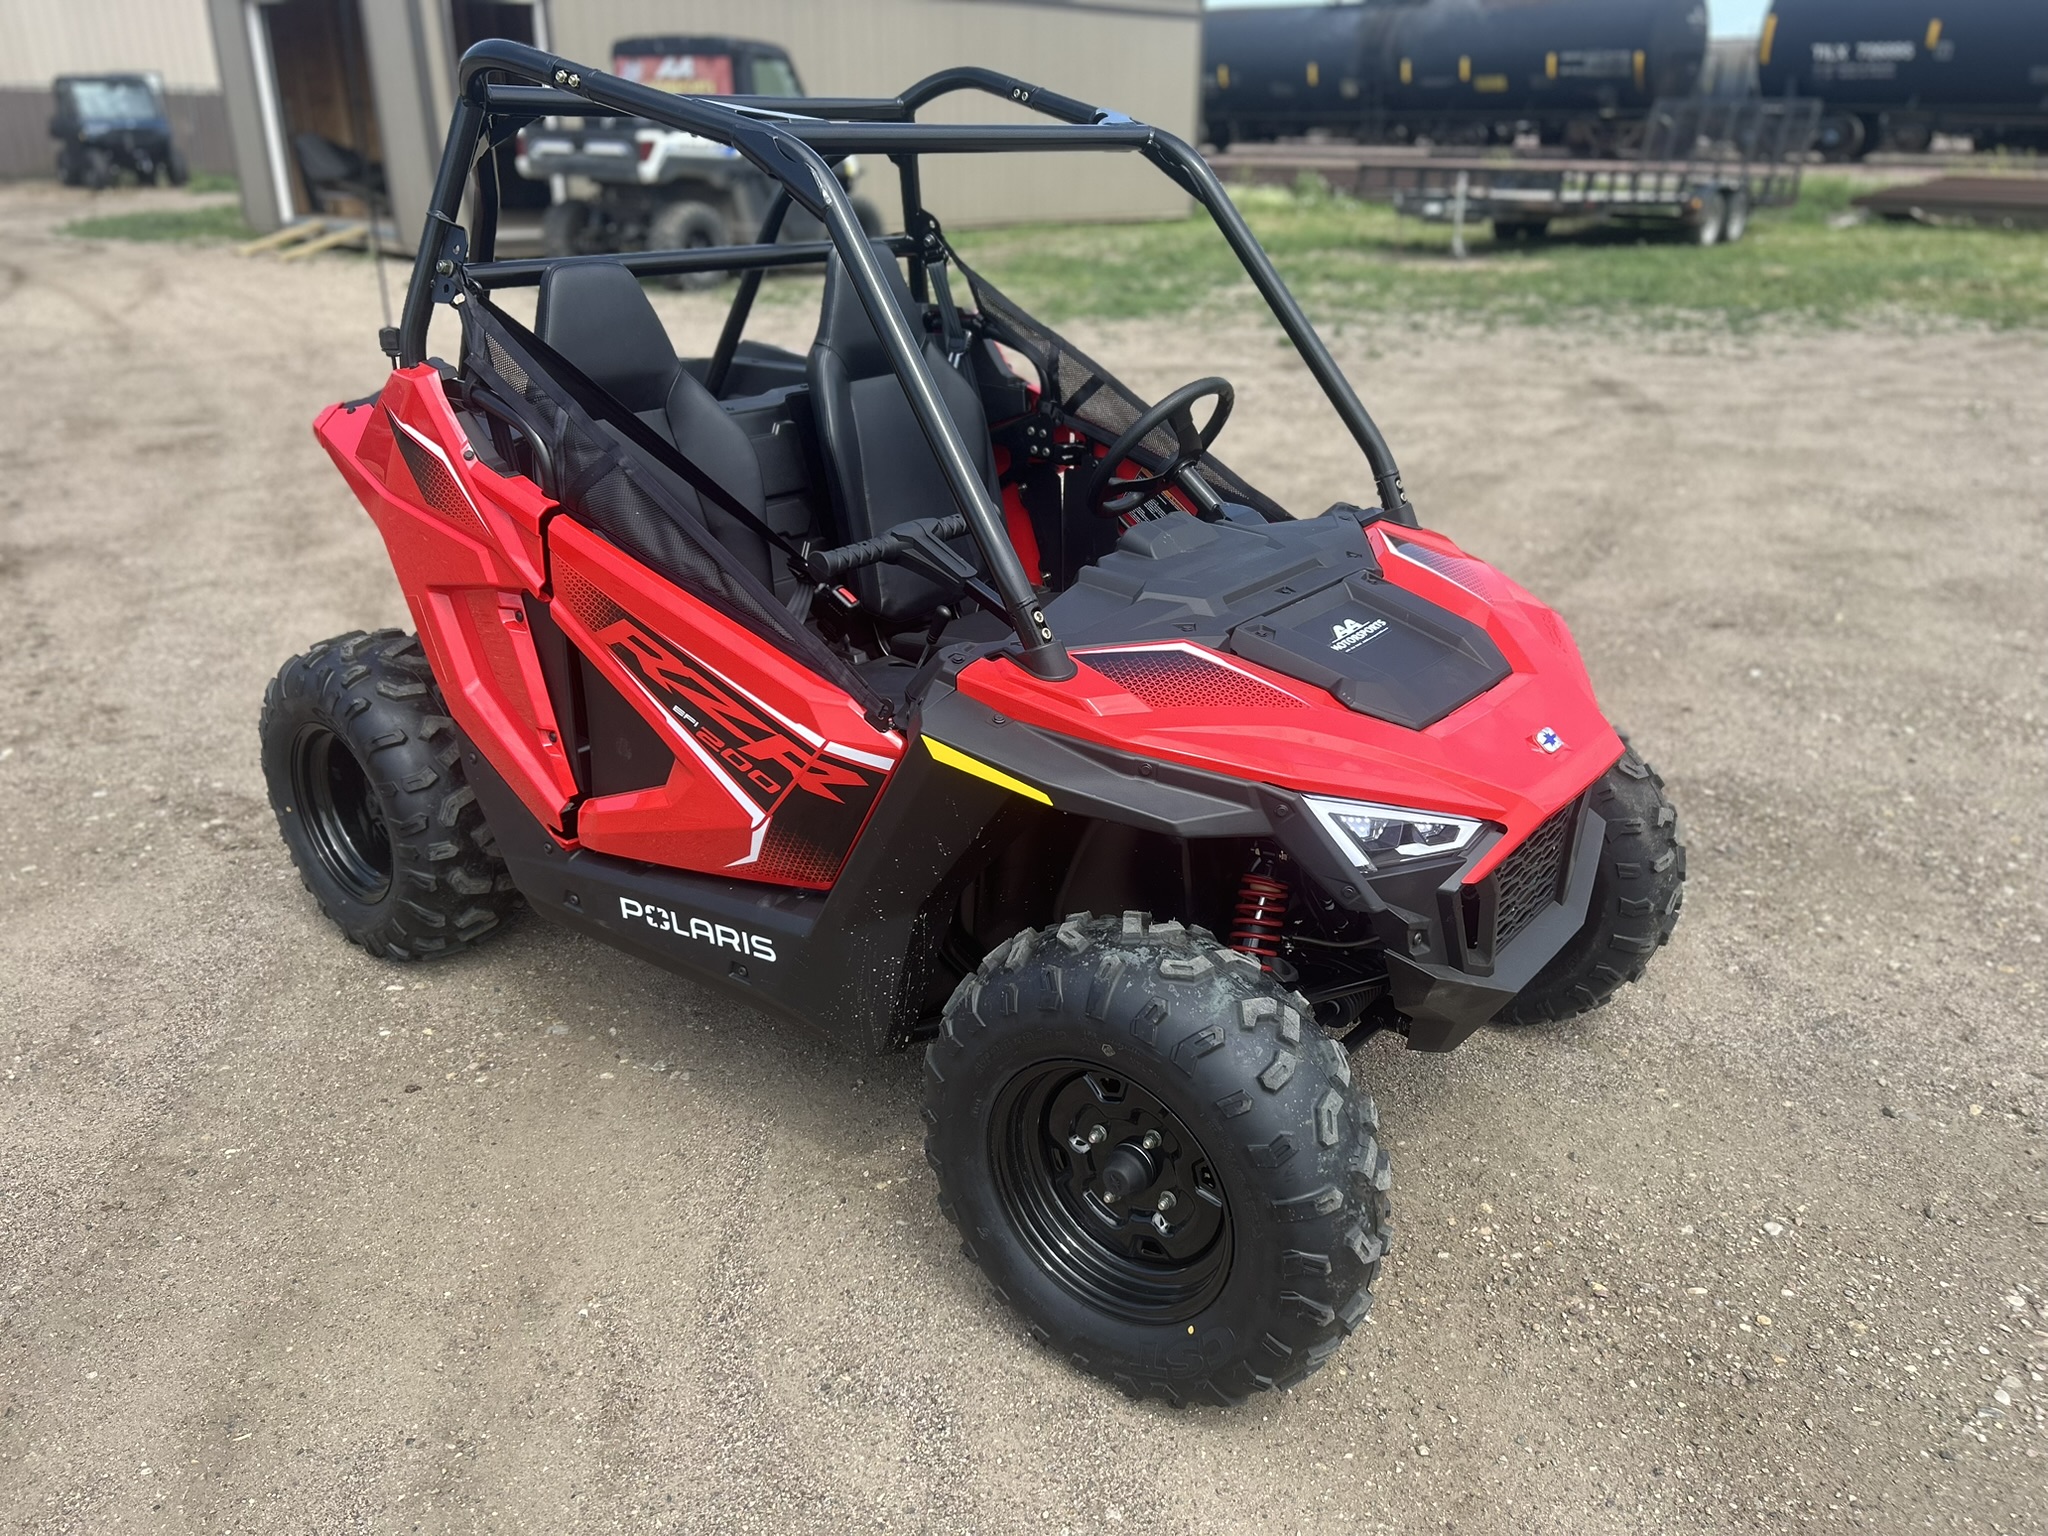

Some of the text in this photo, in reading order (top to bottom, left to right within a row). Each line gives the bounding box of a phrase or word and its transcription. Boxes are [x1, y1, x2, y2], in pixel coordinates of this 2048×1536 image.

[1330, 619, 1387, 651] MOTORSPORTS
[594, 619, 869, 804] RZR
[672, 705, 781, 794] EFI 200
[619, 897, 777, 962] POLARIS
